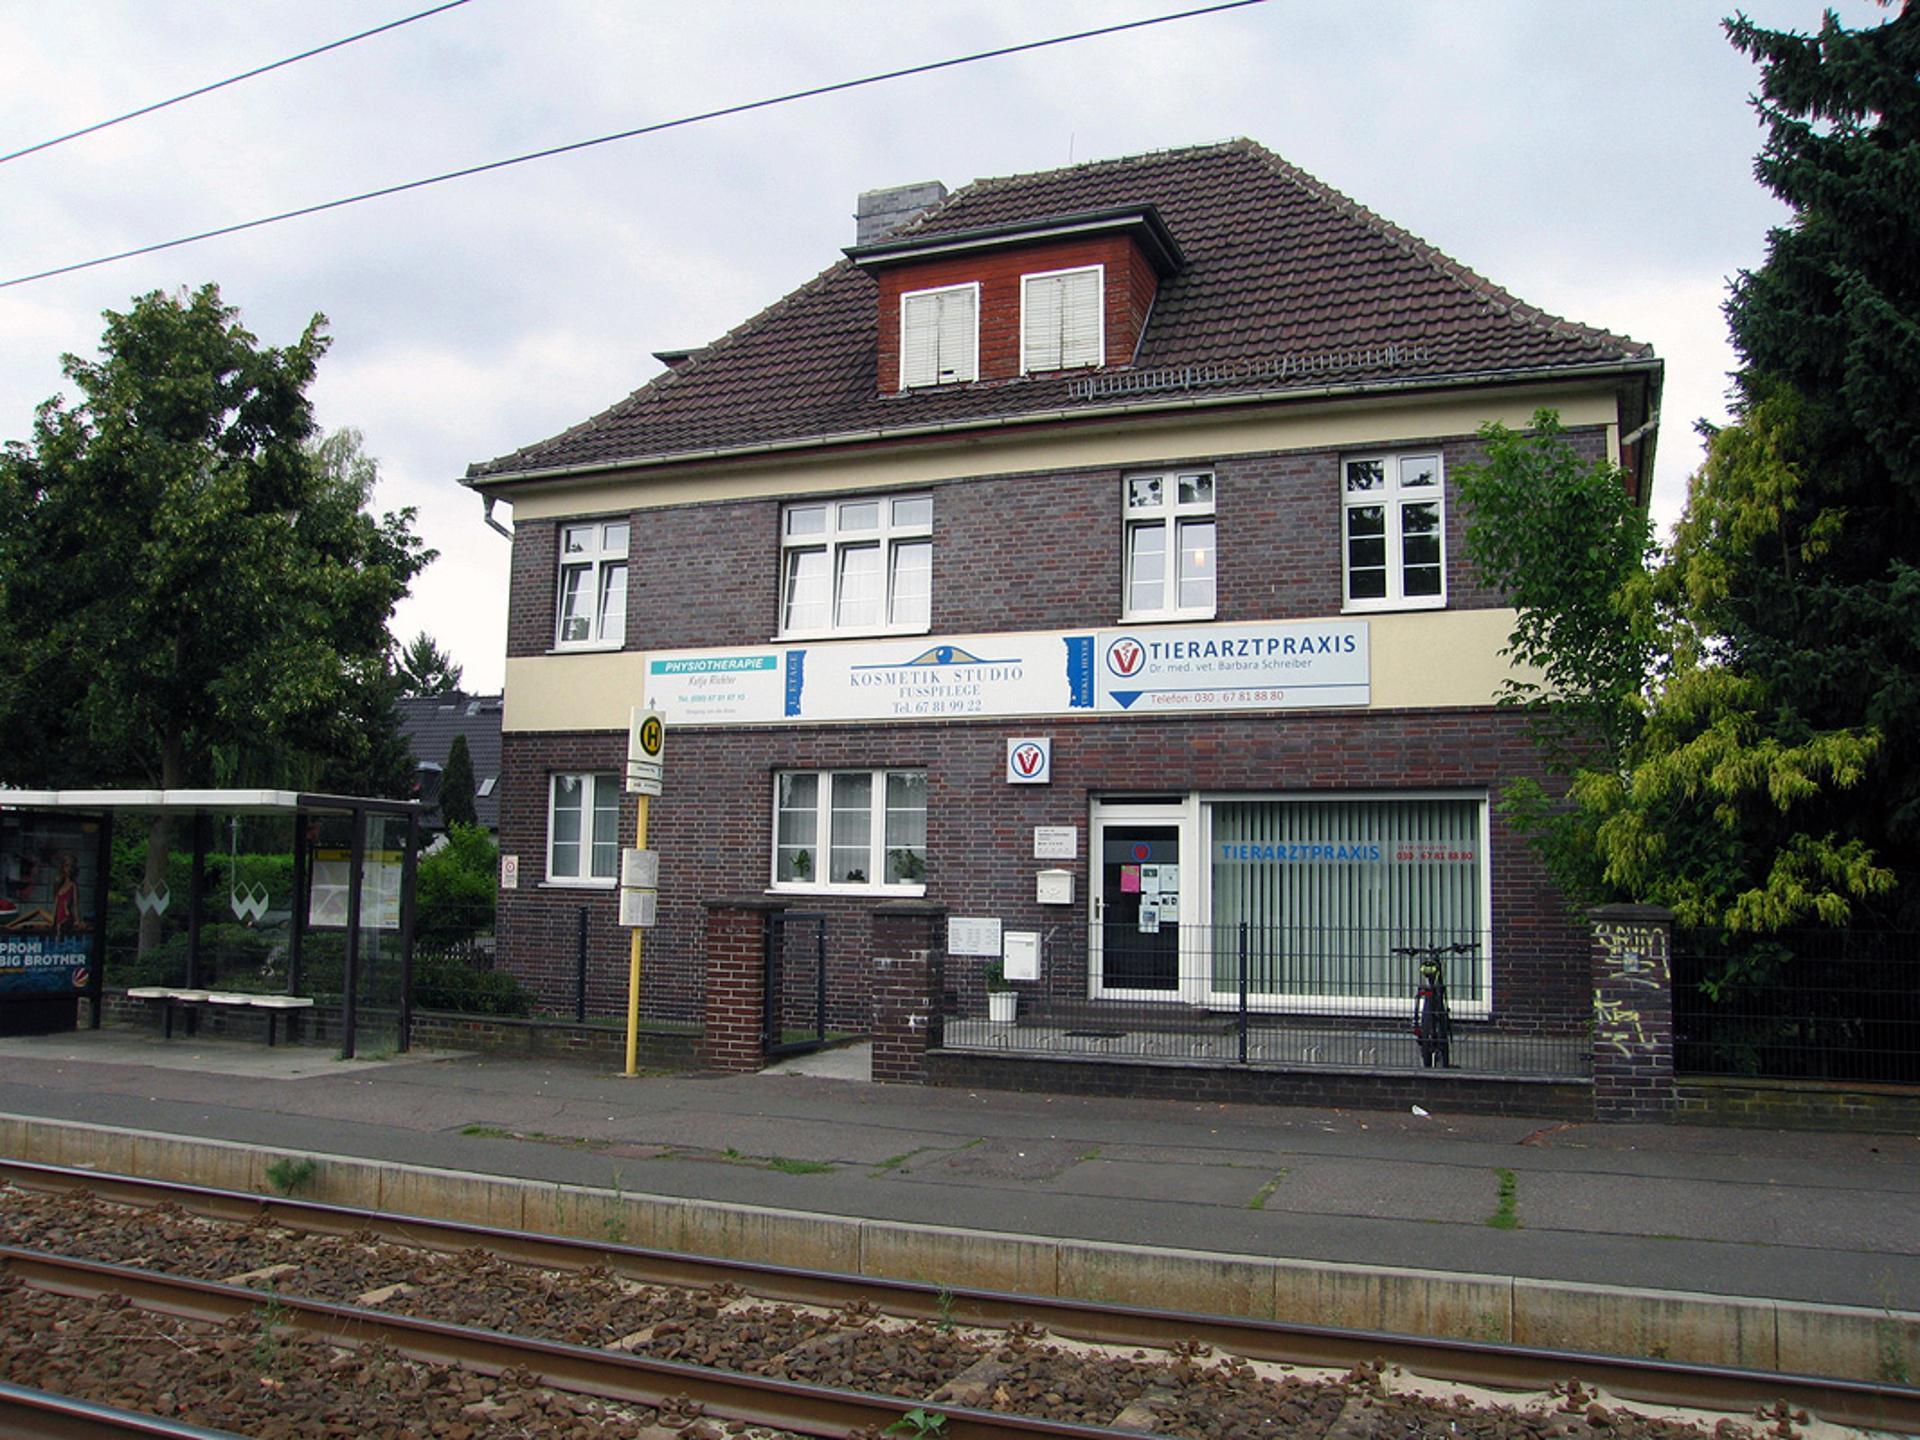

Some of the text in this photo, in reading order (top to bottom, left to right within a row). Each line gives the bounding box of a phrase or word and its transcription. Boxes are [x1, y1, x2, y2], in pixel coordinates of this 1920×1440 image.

[1150, 635, 1356, 660] TIERARZTPRAXIS
[665, 658, 764, 672] PHYSIOTHERAPIE
[1149, 658, 1312, 673] Dr. med. vet. Barbara Schreiber
[850, 667, 1023, 687] KOSMETIK STUDIO
[900, 684, 980, 698] FUSSPFLEGE
[1151, 690, 1284, 705] Telefon: 030 67 81 88 80
[892, 700, 982, 713] Tel. 67 81 99 22
[1221, 844, 1380, 861] TIERARZTPRAXIS
[24, 953, 86, 966] BROTHER
